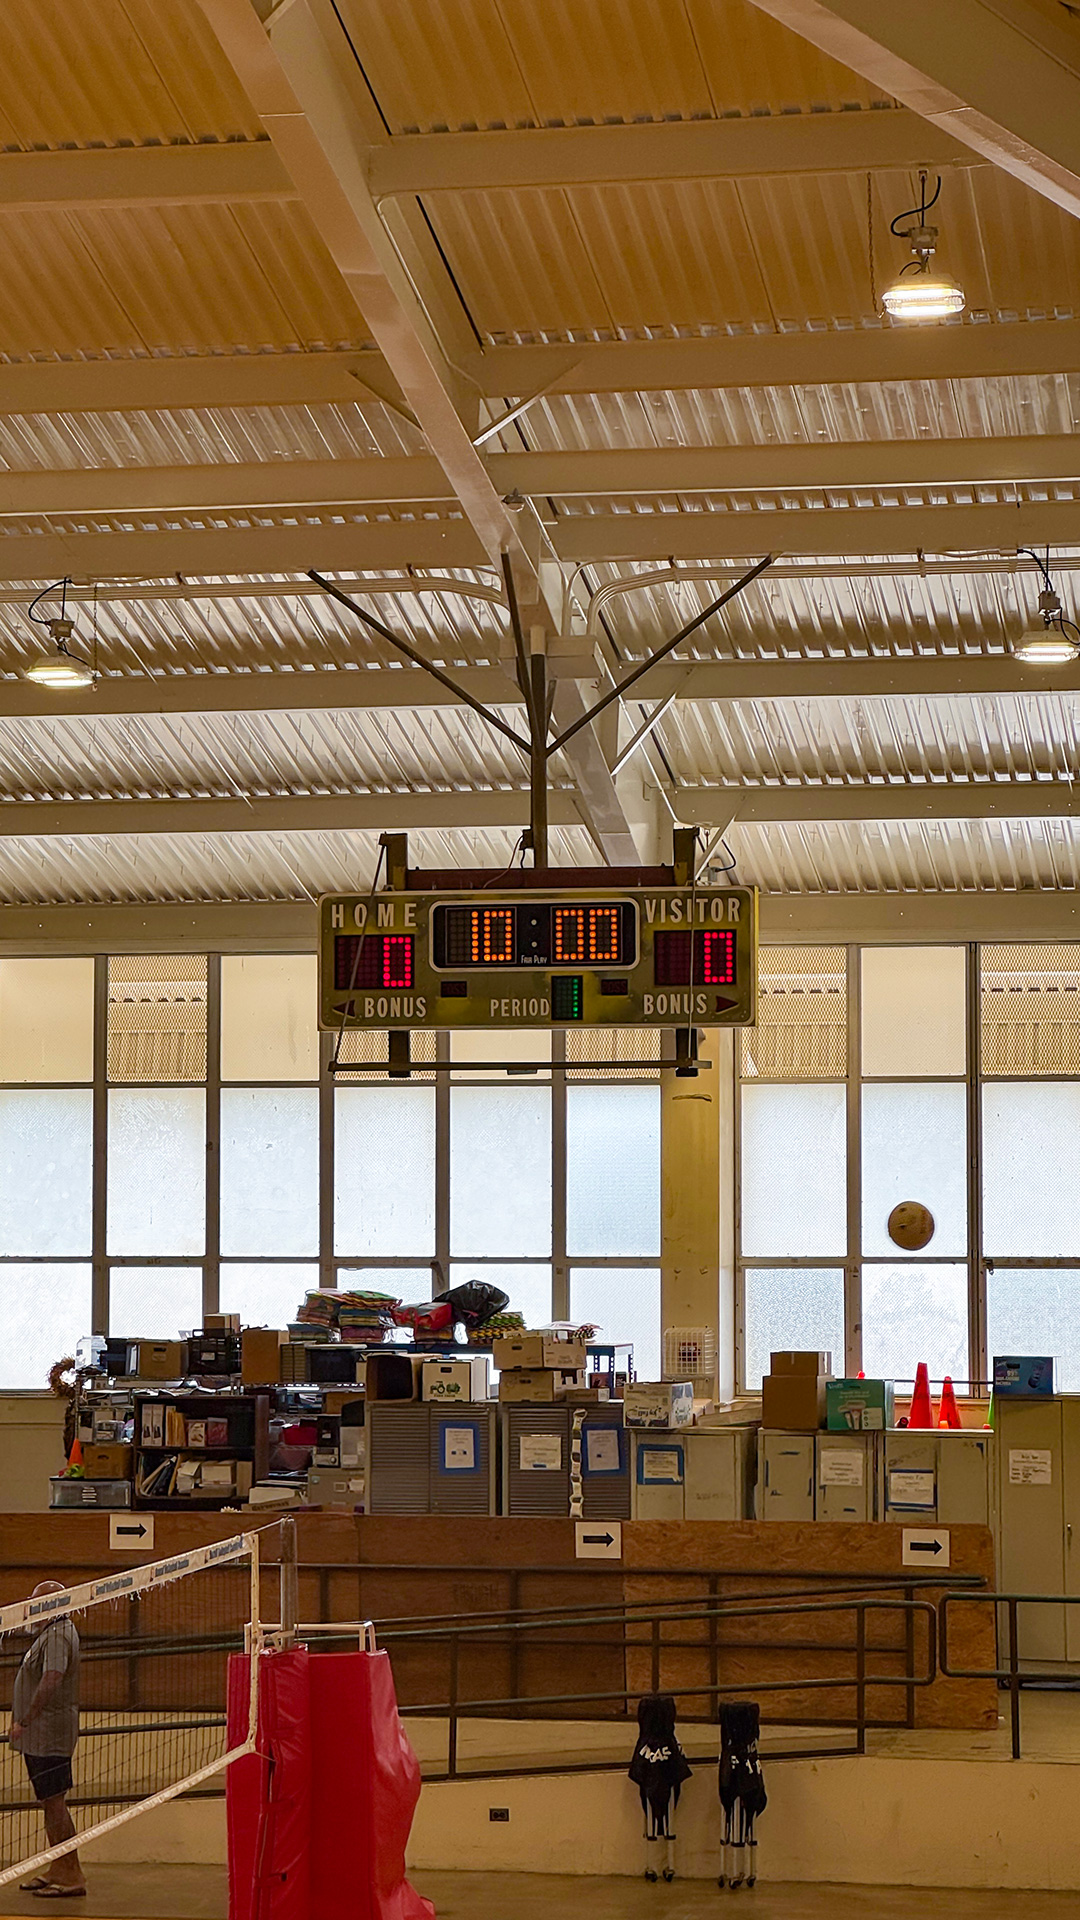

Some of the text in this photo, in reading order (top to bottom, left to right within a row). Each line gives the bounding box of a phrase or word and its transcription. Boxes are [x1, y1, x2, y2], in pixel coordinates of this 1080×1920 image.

[331, 902, 418, 929] HOME
[644, 897, 741, 924] VISITOR
[382, 935, 413, 988] 0
[703, 931, 734, 984] 0
[364, 996, 428, 1018] BONUS
[490, 997, 551, 1018] PERIOD
[643, 993, 708, 1015] BONUS
